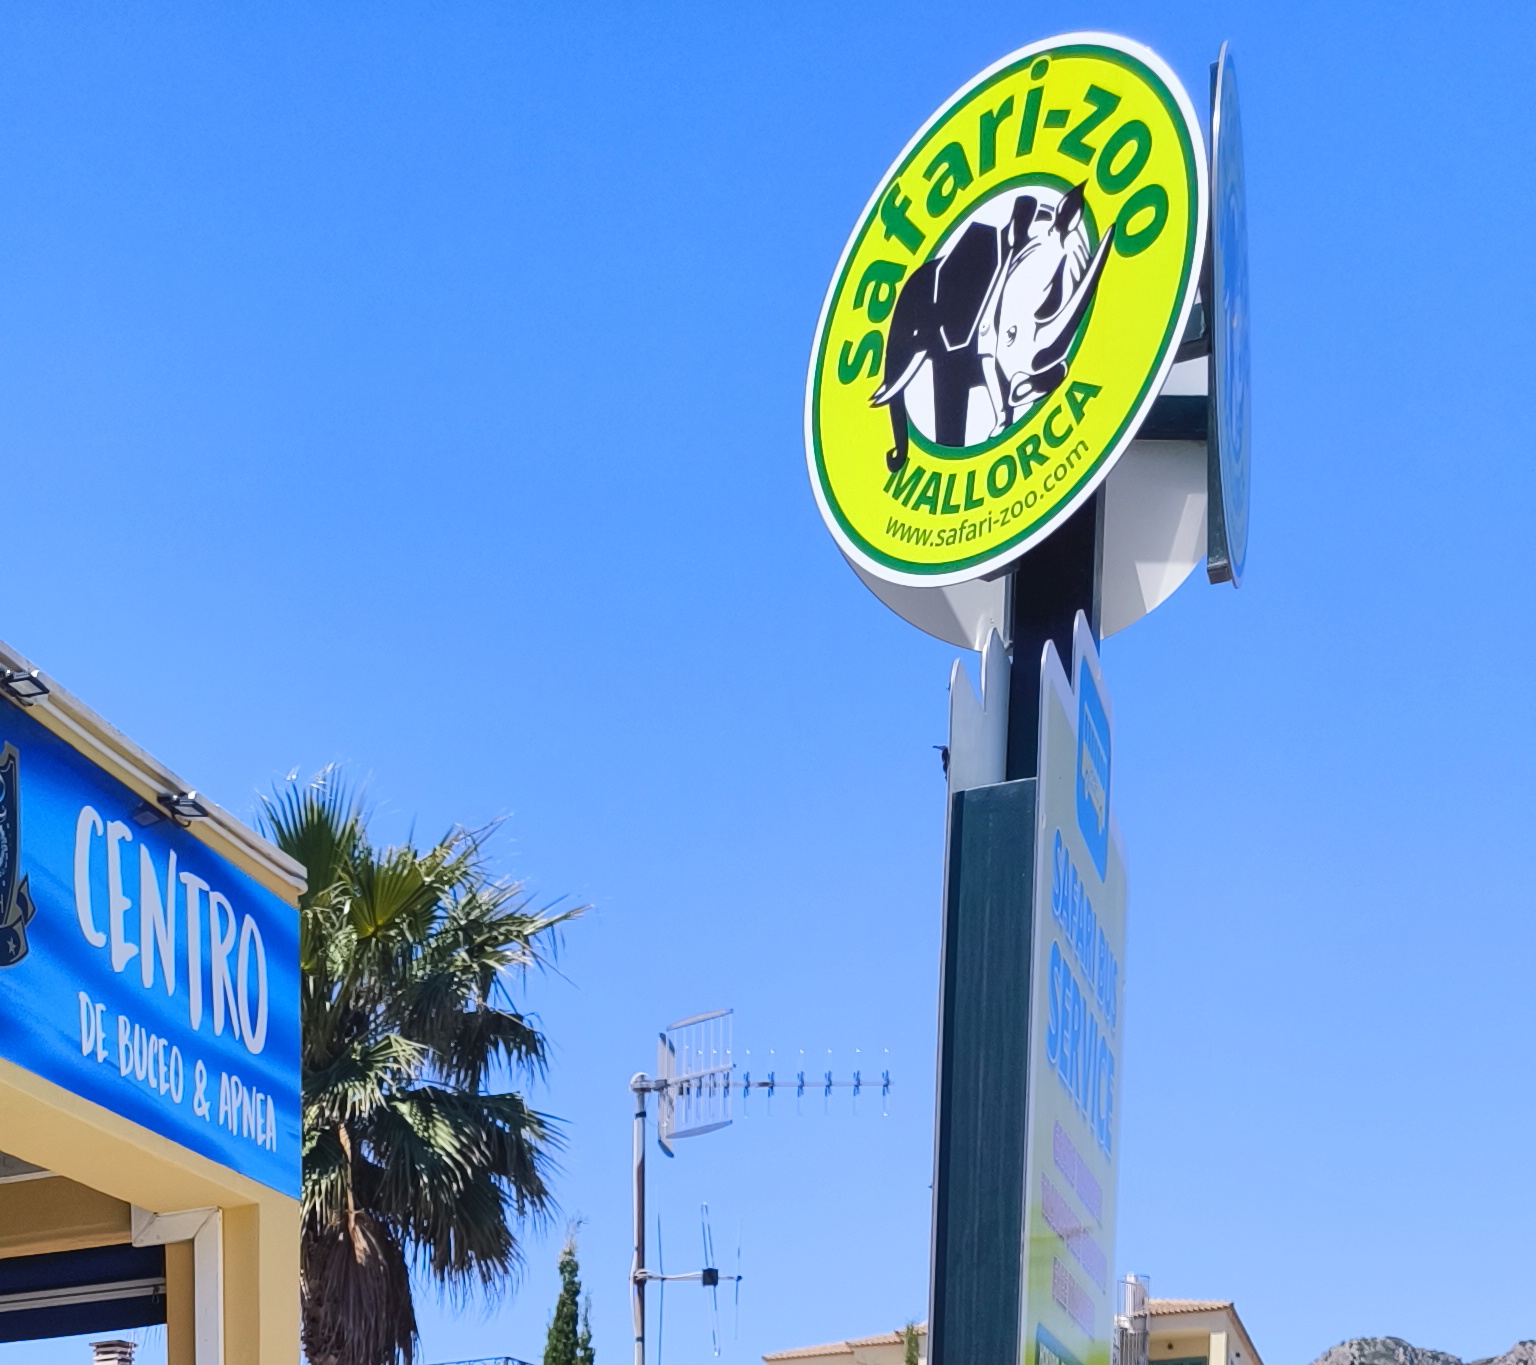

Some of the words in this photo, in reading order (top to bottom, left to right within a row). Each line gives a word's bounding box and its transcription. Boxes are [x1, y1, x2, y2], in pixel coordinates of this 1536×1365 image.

[837, 54, 1169, 387] safari-zoo
[882, 379, 1103, 515] MALLORCA
[885, 439, 1090, 548] www.safari-zoo.com
[74, 804, 267, 1055] CENTRO
[1051, 828, 1097, 992] SAFARI
[1097, 927, 1118, 1036] BUS
[78, 991, 108, 1063] DE
[118, 1016, 184, 1104] BUCEO
[194, 1059, 211, 1124] &
[219, 1071, 278, 1153] APNEA
[1047, 941, 1116, 1161] SERVICE
